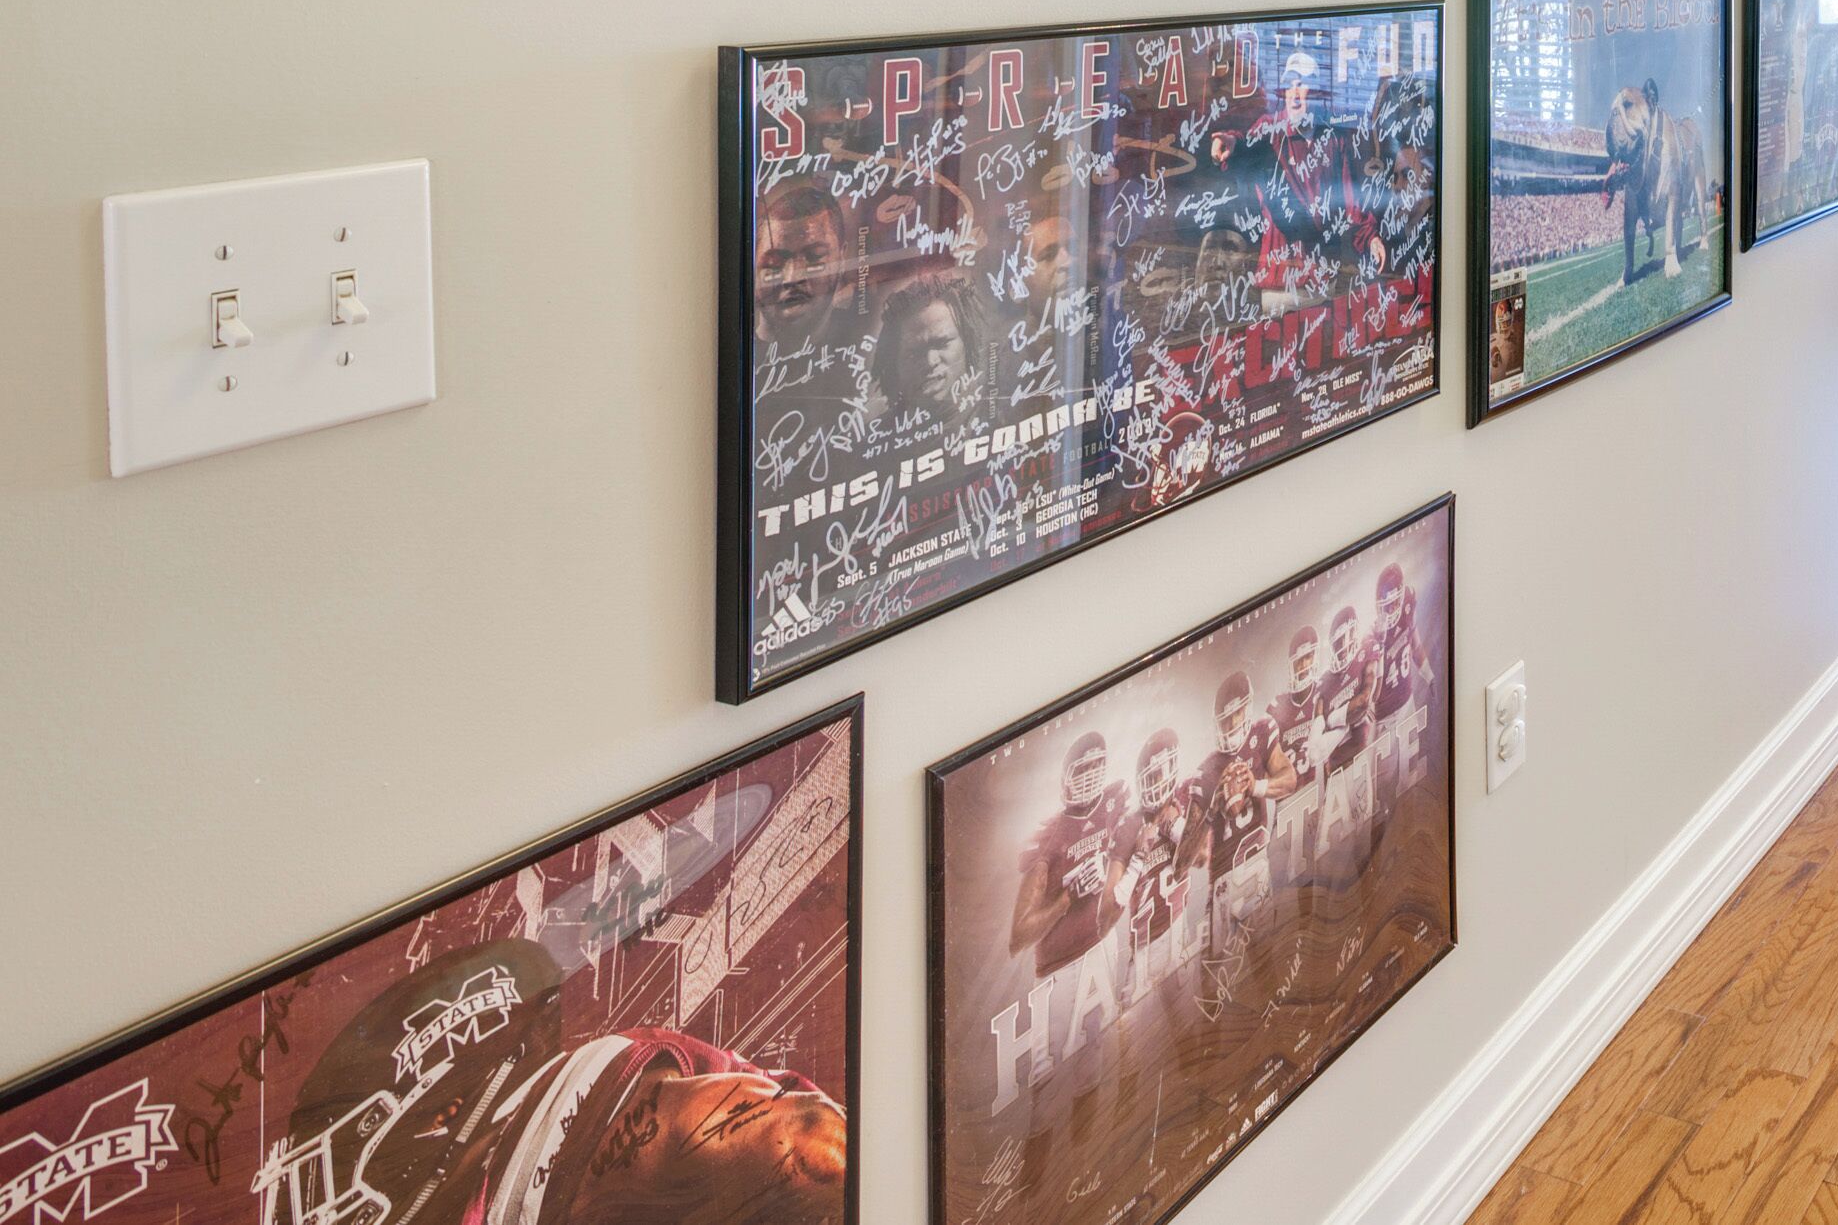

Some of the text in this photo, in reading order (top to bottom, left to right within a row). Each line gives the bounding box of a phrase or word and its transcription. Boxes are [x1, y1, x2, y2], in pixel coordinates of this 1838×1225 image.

[858, 226, 870, 316] Derek Sherrod
[989, 342, 999, 386] Anthony
[1089, 331, 1099, 366] McRae
[1332, 379, 1344, 391] OLE
[1380, 375, 1435, 407] 888-GO-DAWGS
[1218, 423, 1234, 437] Oct.
[1235, 416, 1246, 430] 24
[757, 470, 880, 538] THIS
[898, 448, 946, 490] IS
[963, 397, 1098, 466] GONNA
[1111, 376, 1156, 414] BE
[1035, 502, 1074, 524] GEORGIA
[1075, 490, 1098, 511] TECH
[990, 503, 1099, 558] Oct. 10 HOUSTON (HC)
[837, 524, 972, 589] Sept. 5 JACKSON STATE
[913, 543, 969, 576] Maroon Game)
[753, 617, 824, 657] adidas
[1230, 705, 1428, 921] STATE
[419, 991, 497, 1048] STATE
